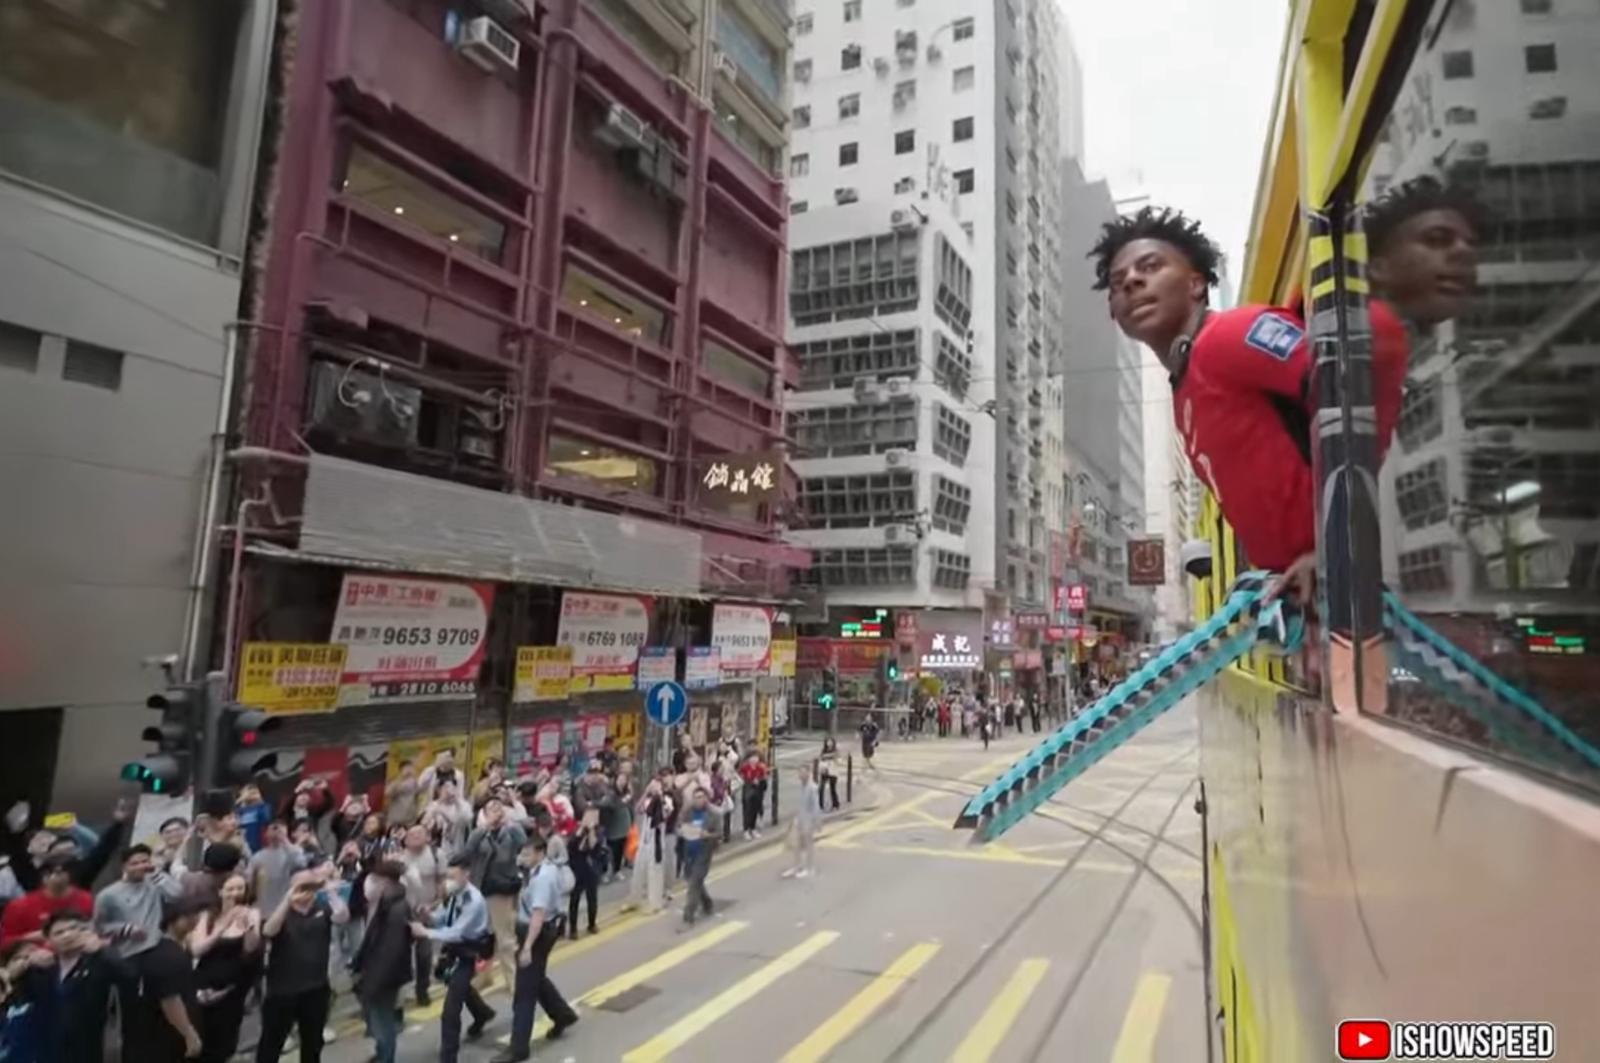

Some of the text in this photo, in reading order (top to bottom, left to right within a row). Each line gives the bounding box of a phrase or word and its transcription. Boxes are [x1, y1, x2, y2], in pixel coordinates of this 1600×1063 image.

[383, 626, 431, 645] 9653
[437, 627, 479, 645] 9709
[587, 631, 616, 646] 6769
